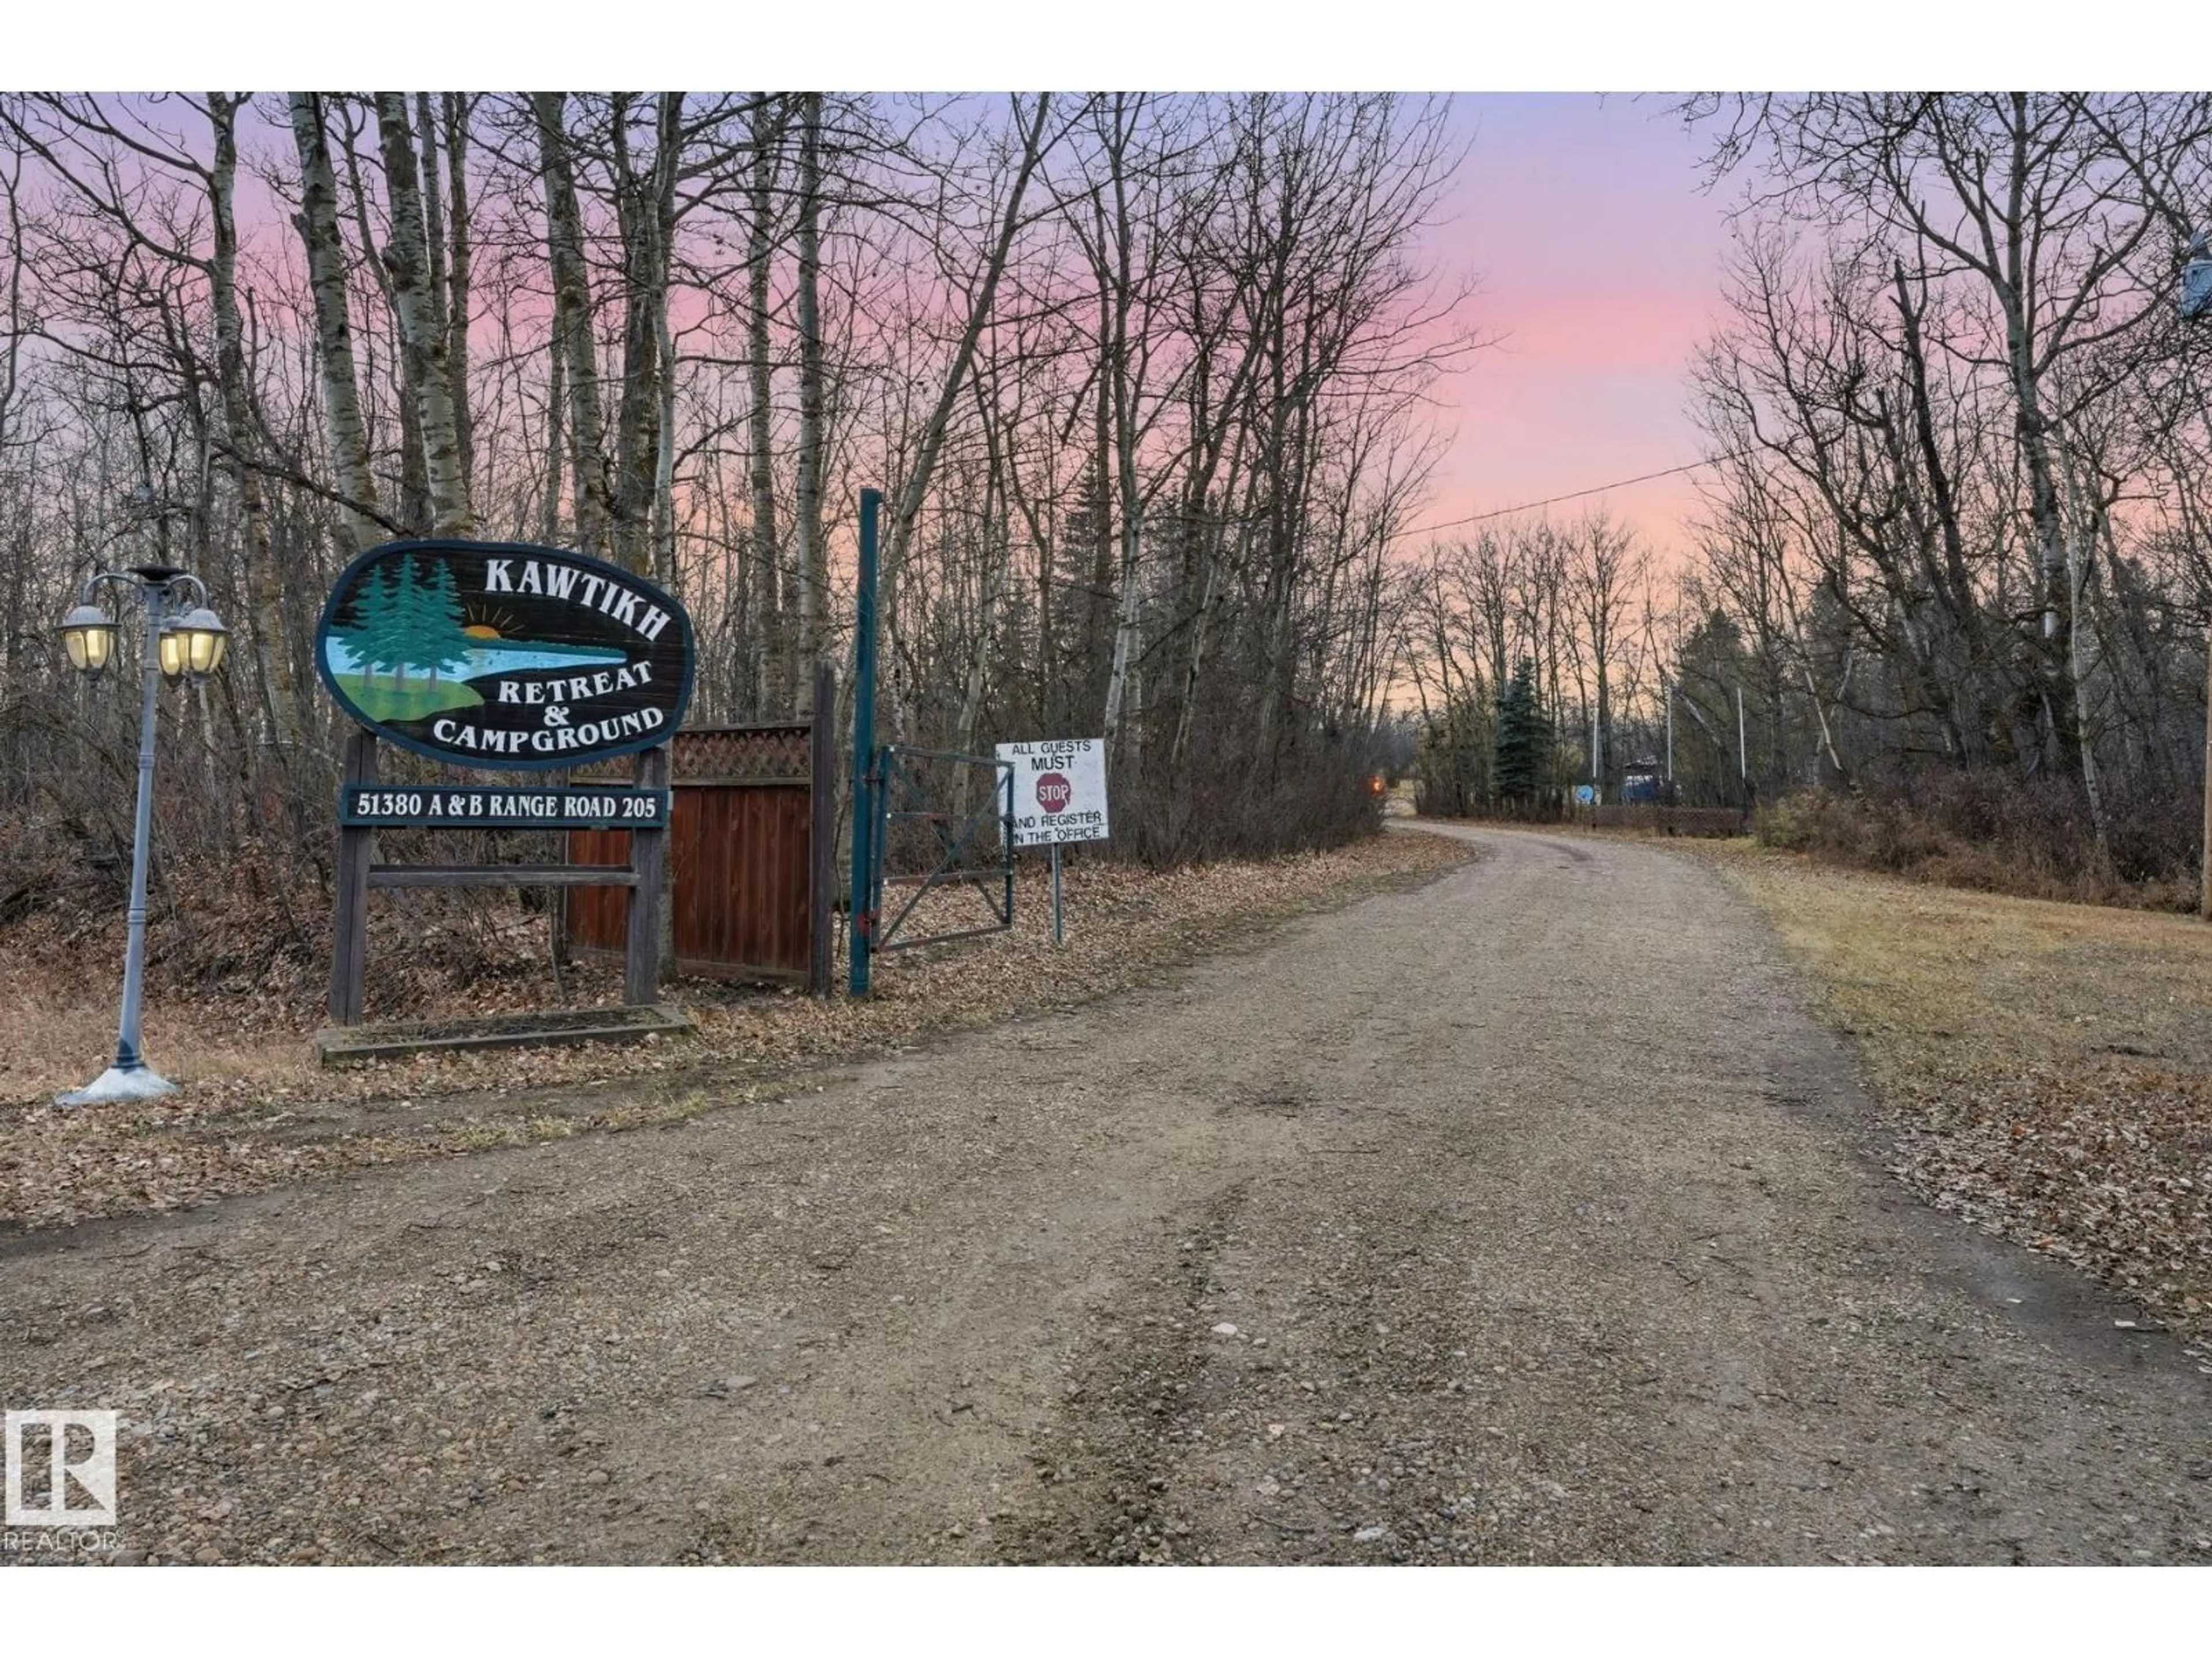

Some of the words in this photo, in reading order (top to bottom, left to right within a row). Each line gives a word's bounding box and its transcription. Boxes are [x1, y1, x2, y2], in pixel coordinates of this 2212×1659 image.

[485, 558, 671, 642] KAWTIKH
[498, 660, 653, 704] RETREAT
[543, 705, 570, 728] &
[433, 706, 664, 753] CAMPGROUND
[1012, 744, 1035, 755] ALL
[1041, 739, 1091, 753] GUESTS
[1031, 756, 1075, 771] MUST
[1039, 785, 1069, 801] STOP
[356, 793, 422, 816] 51380
[428, 794, 444, 815] A
[448, 794, 466, 815] &
[468, 795, 483, 816] B
[488, 795, 559, 817] RANGE
[564, 796, 617, 817] ROAD
[622, 796, 657, 818] 205
[1041, 810, 1102, 827] REGISTER
[1028, 831, 1052, 843] THE
[1057, 826, 1100, 842] OFFICE
